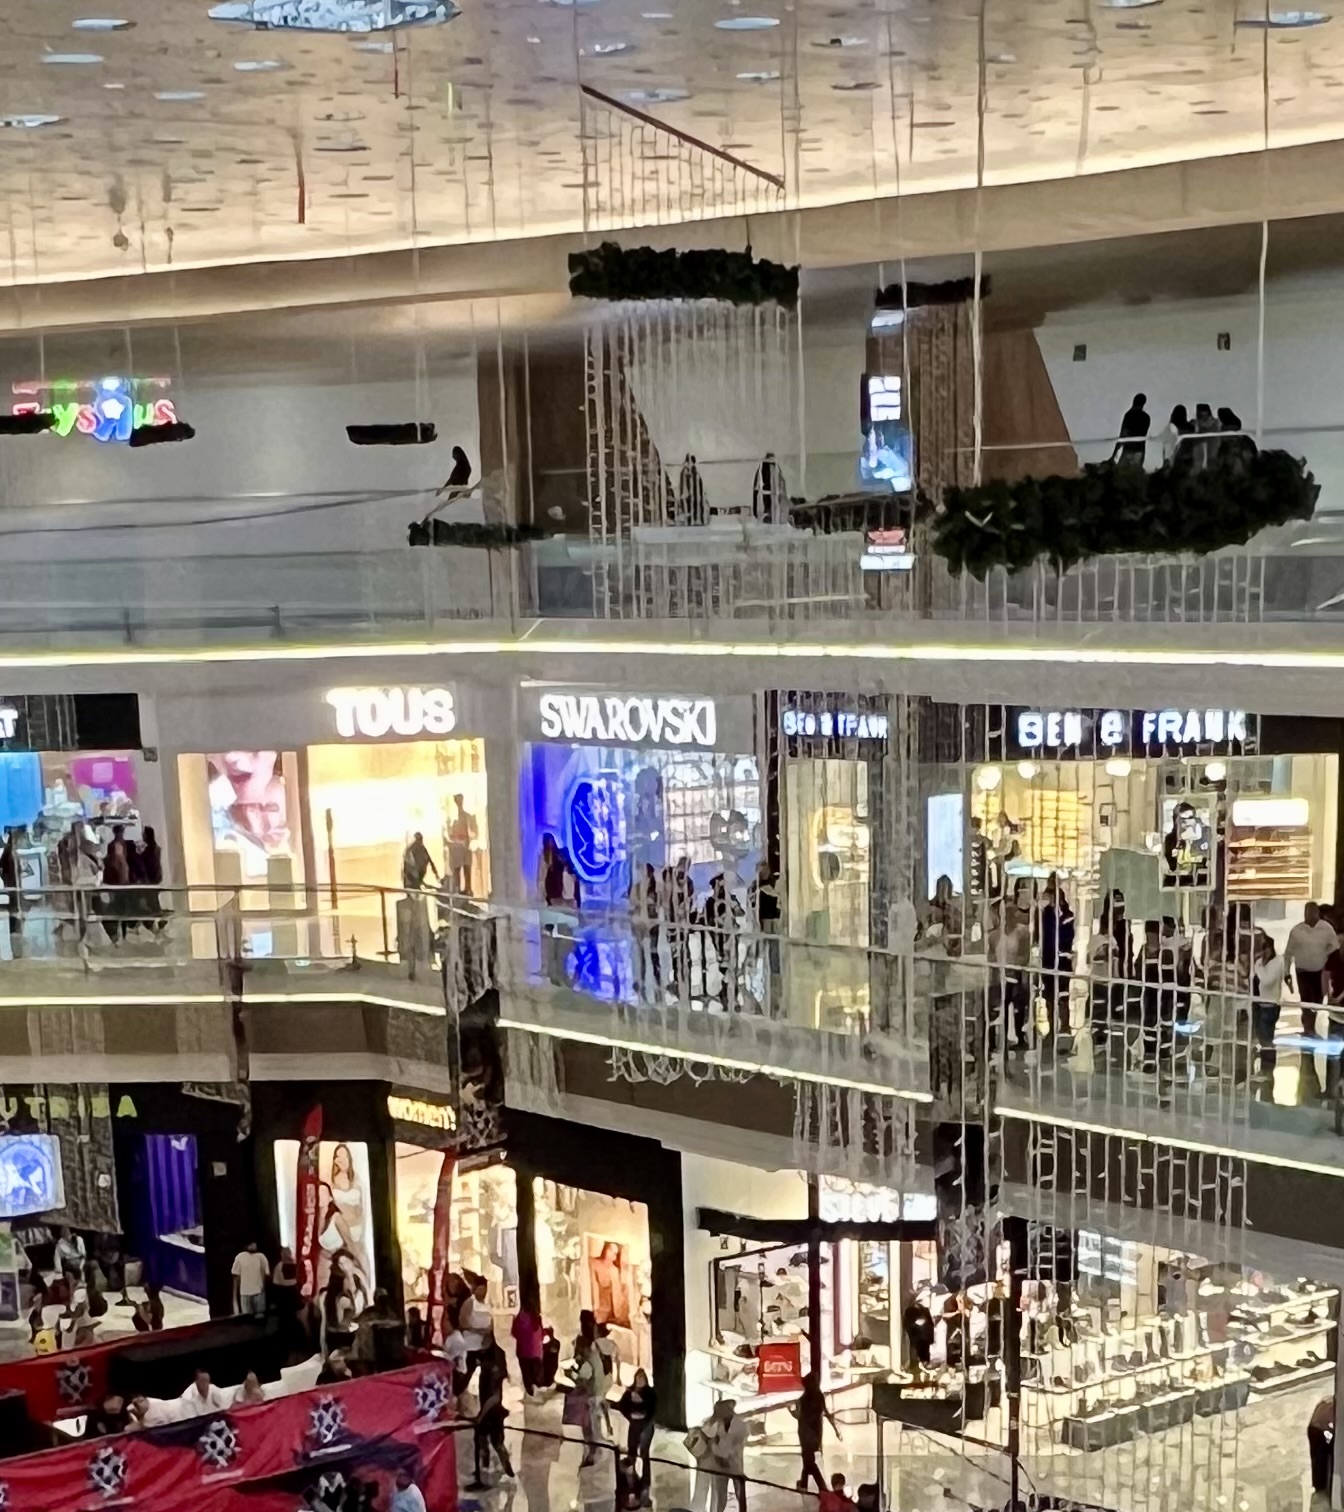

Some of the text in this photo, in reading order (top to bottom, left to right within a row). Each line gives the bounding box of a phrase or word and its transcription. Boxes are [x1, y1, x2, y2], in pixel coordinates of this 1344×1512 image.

[325, 686, 456, 737] TOUS
[539, 695, 717, 746] SWAROVSKI
[1017, 711, 1084, 748] BEN
[1142, 708, 1248, 744] FRANK
